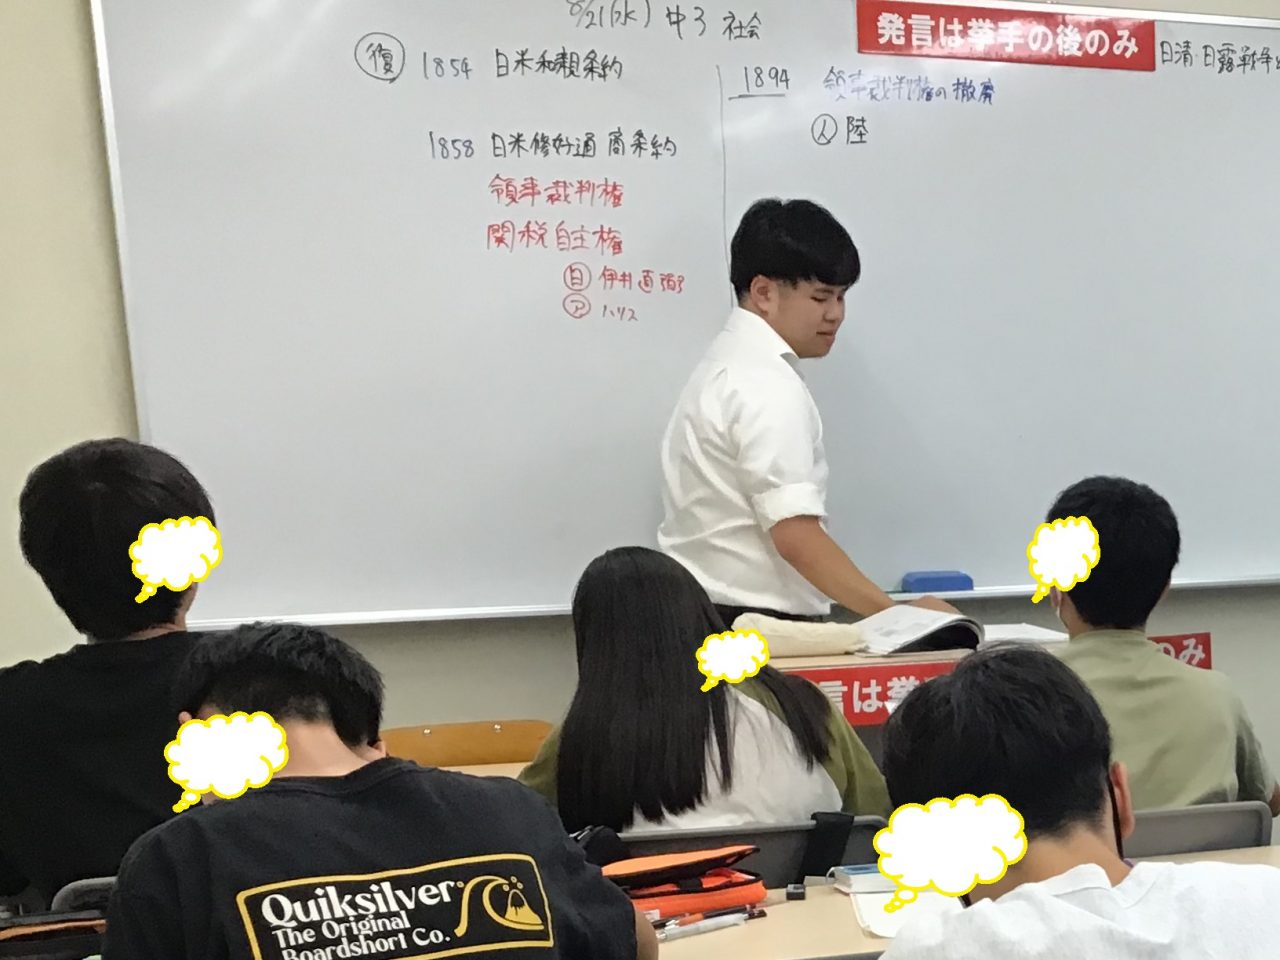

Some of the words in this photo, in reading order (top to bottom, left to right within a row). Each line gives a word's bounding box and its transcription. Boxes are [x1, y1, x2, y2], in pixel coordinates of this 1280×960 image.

[722, 11, 762, 41] 社会
[876, 12, 1139, 59] 発言は挙手の後のみ
[422, 52, 473, 80] 1854
[495, 46, 624, 82] 日米和親条約
[743, 66, 790, 93] 1894
[428, 131, 475, 160] 1858
[846, 116, 869, 145] 陸
[487, 173, 624, 208] 領事裁判権
[486, 220, 624, 256] 関税自主権
[261, 880, 456, 929] Quiksilver
[272, 926, 317, 950] The
[321, 911, 412, 940] Original
[412, 926, 451, 947] Co.
